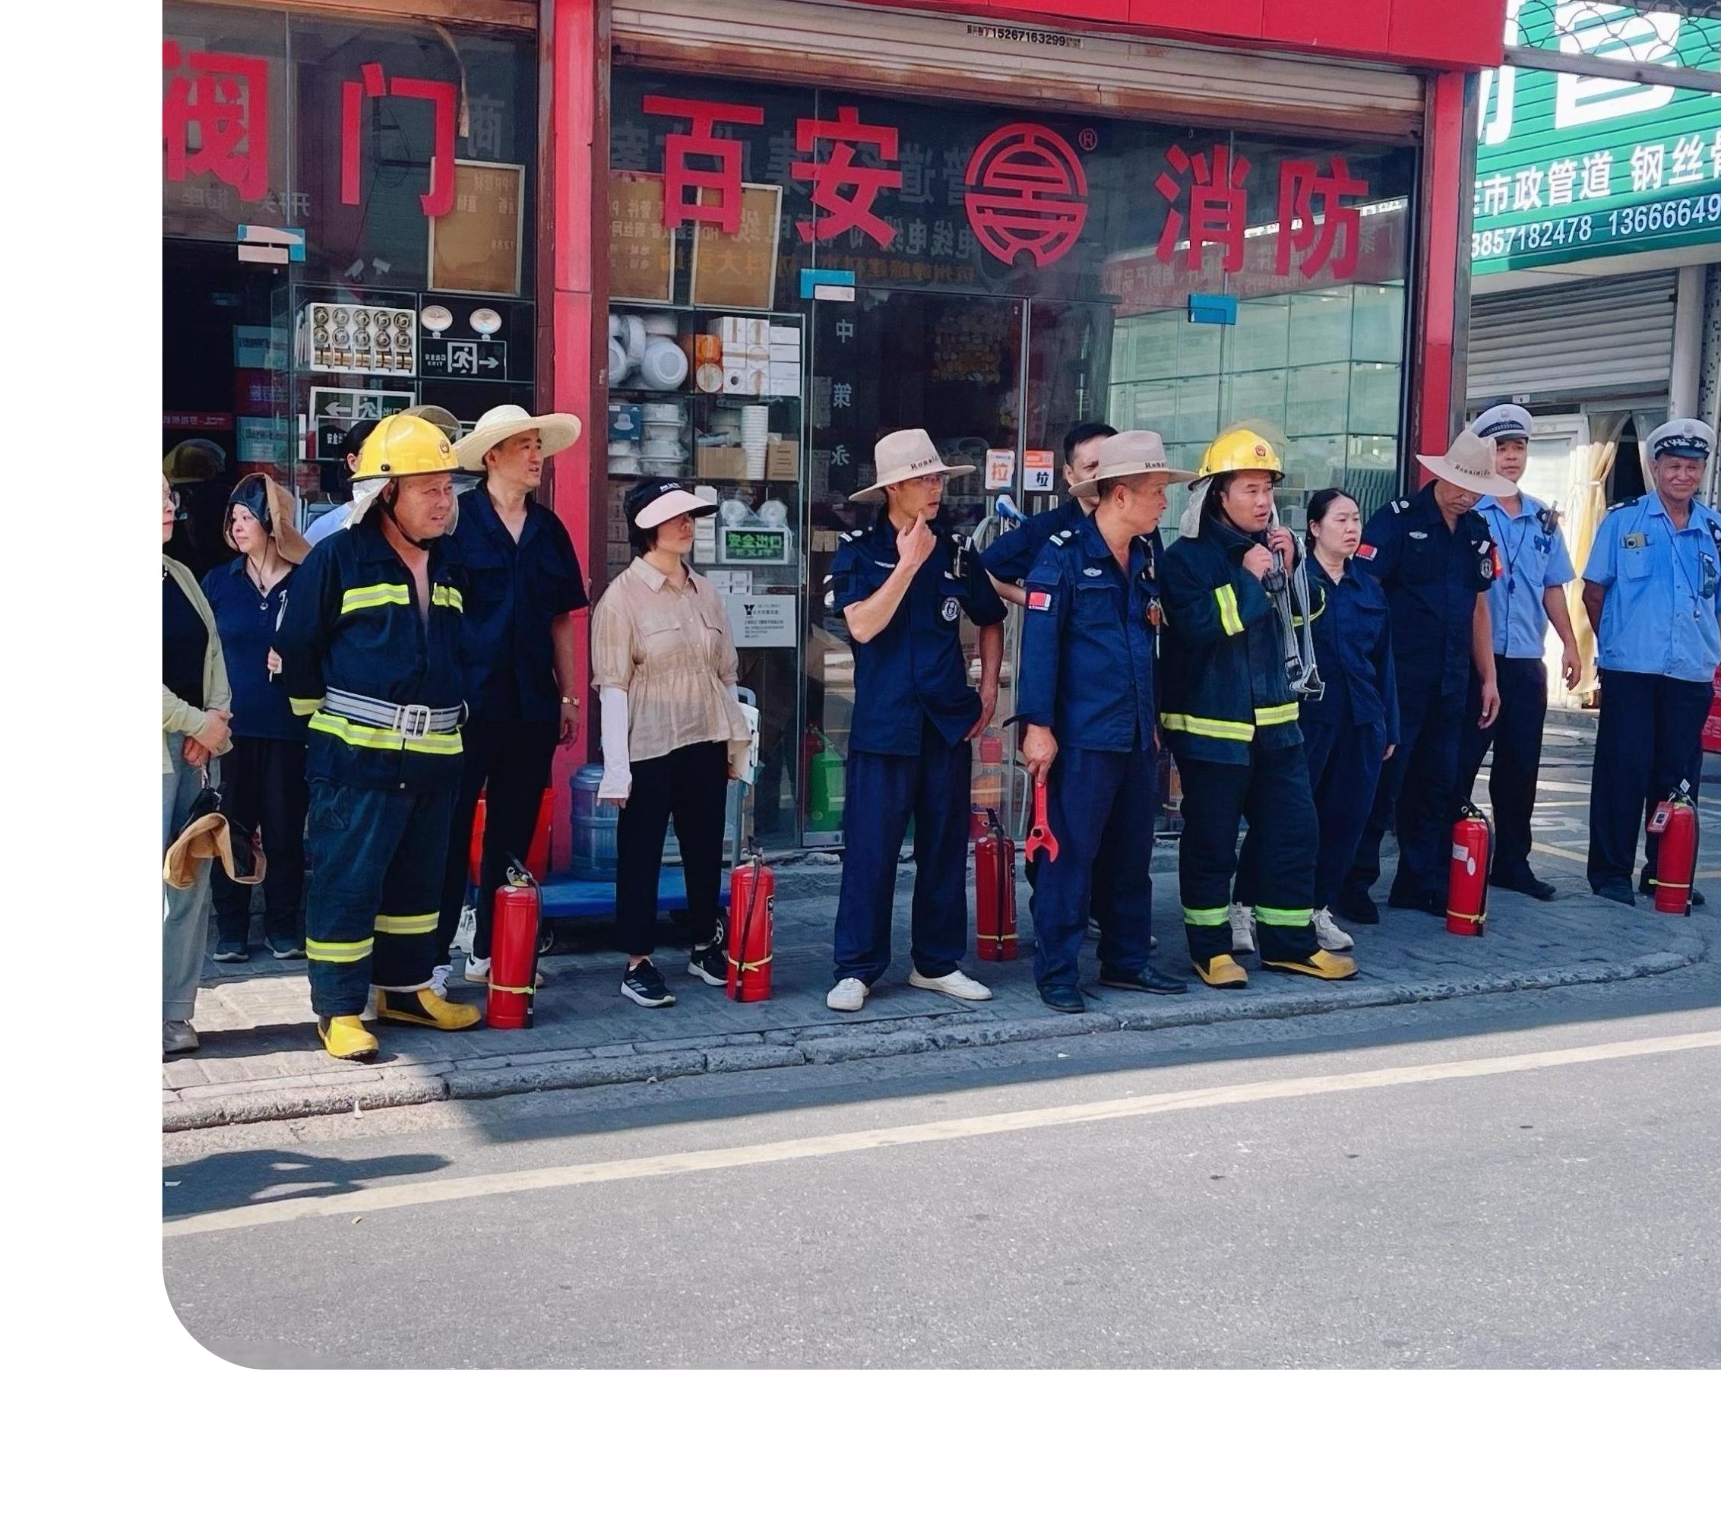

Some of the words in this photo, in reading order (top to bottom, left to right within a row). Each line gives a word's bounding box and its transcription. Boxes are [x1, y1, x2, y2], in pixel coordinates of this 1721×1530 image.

[162, 38, 457, 217] 阀门
[642, 94, 901, 248] 百安
[1154, 143, 1370, 280] 消防
[990, 460, 1008, 481] 拉
[1035, 470, 1050, 487] 拉
